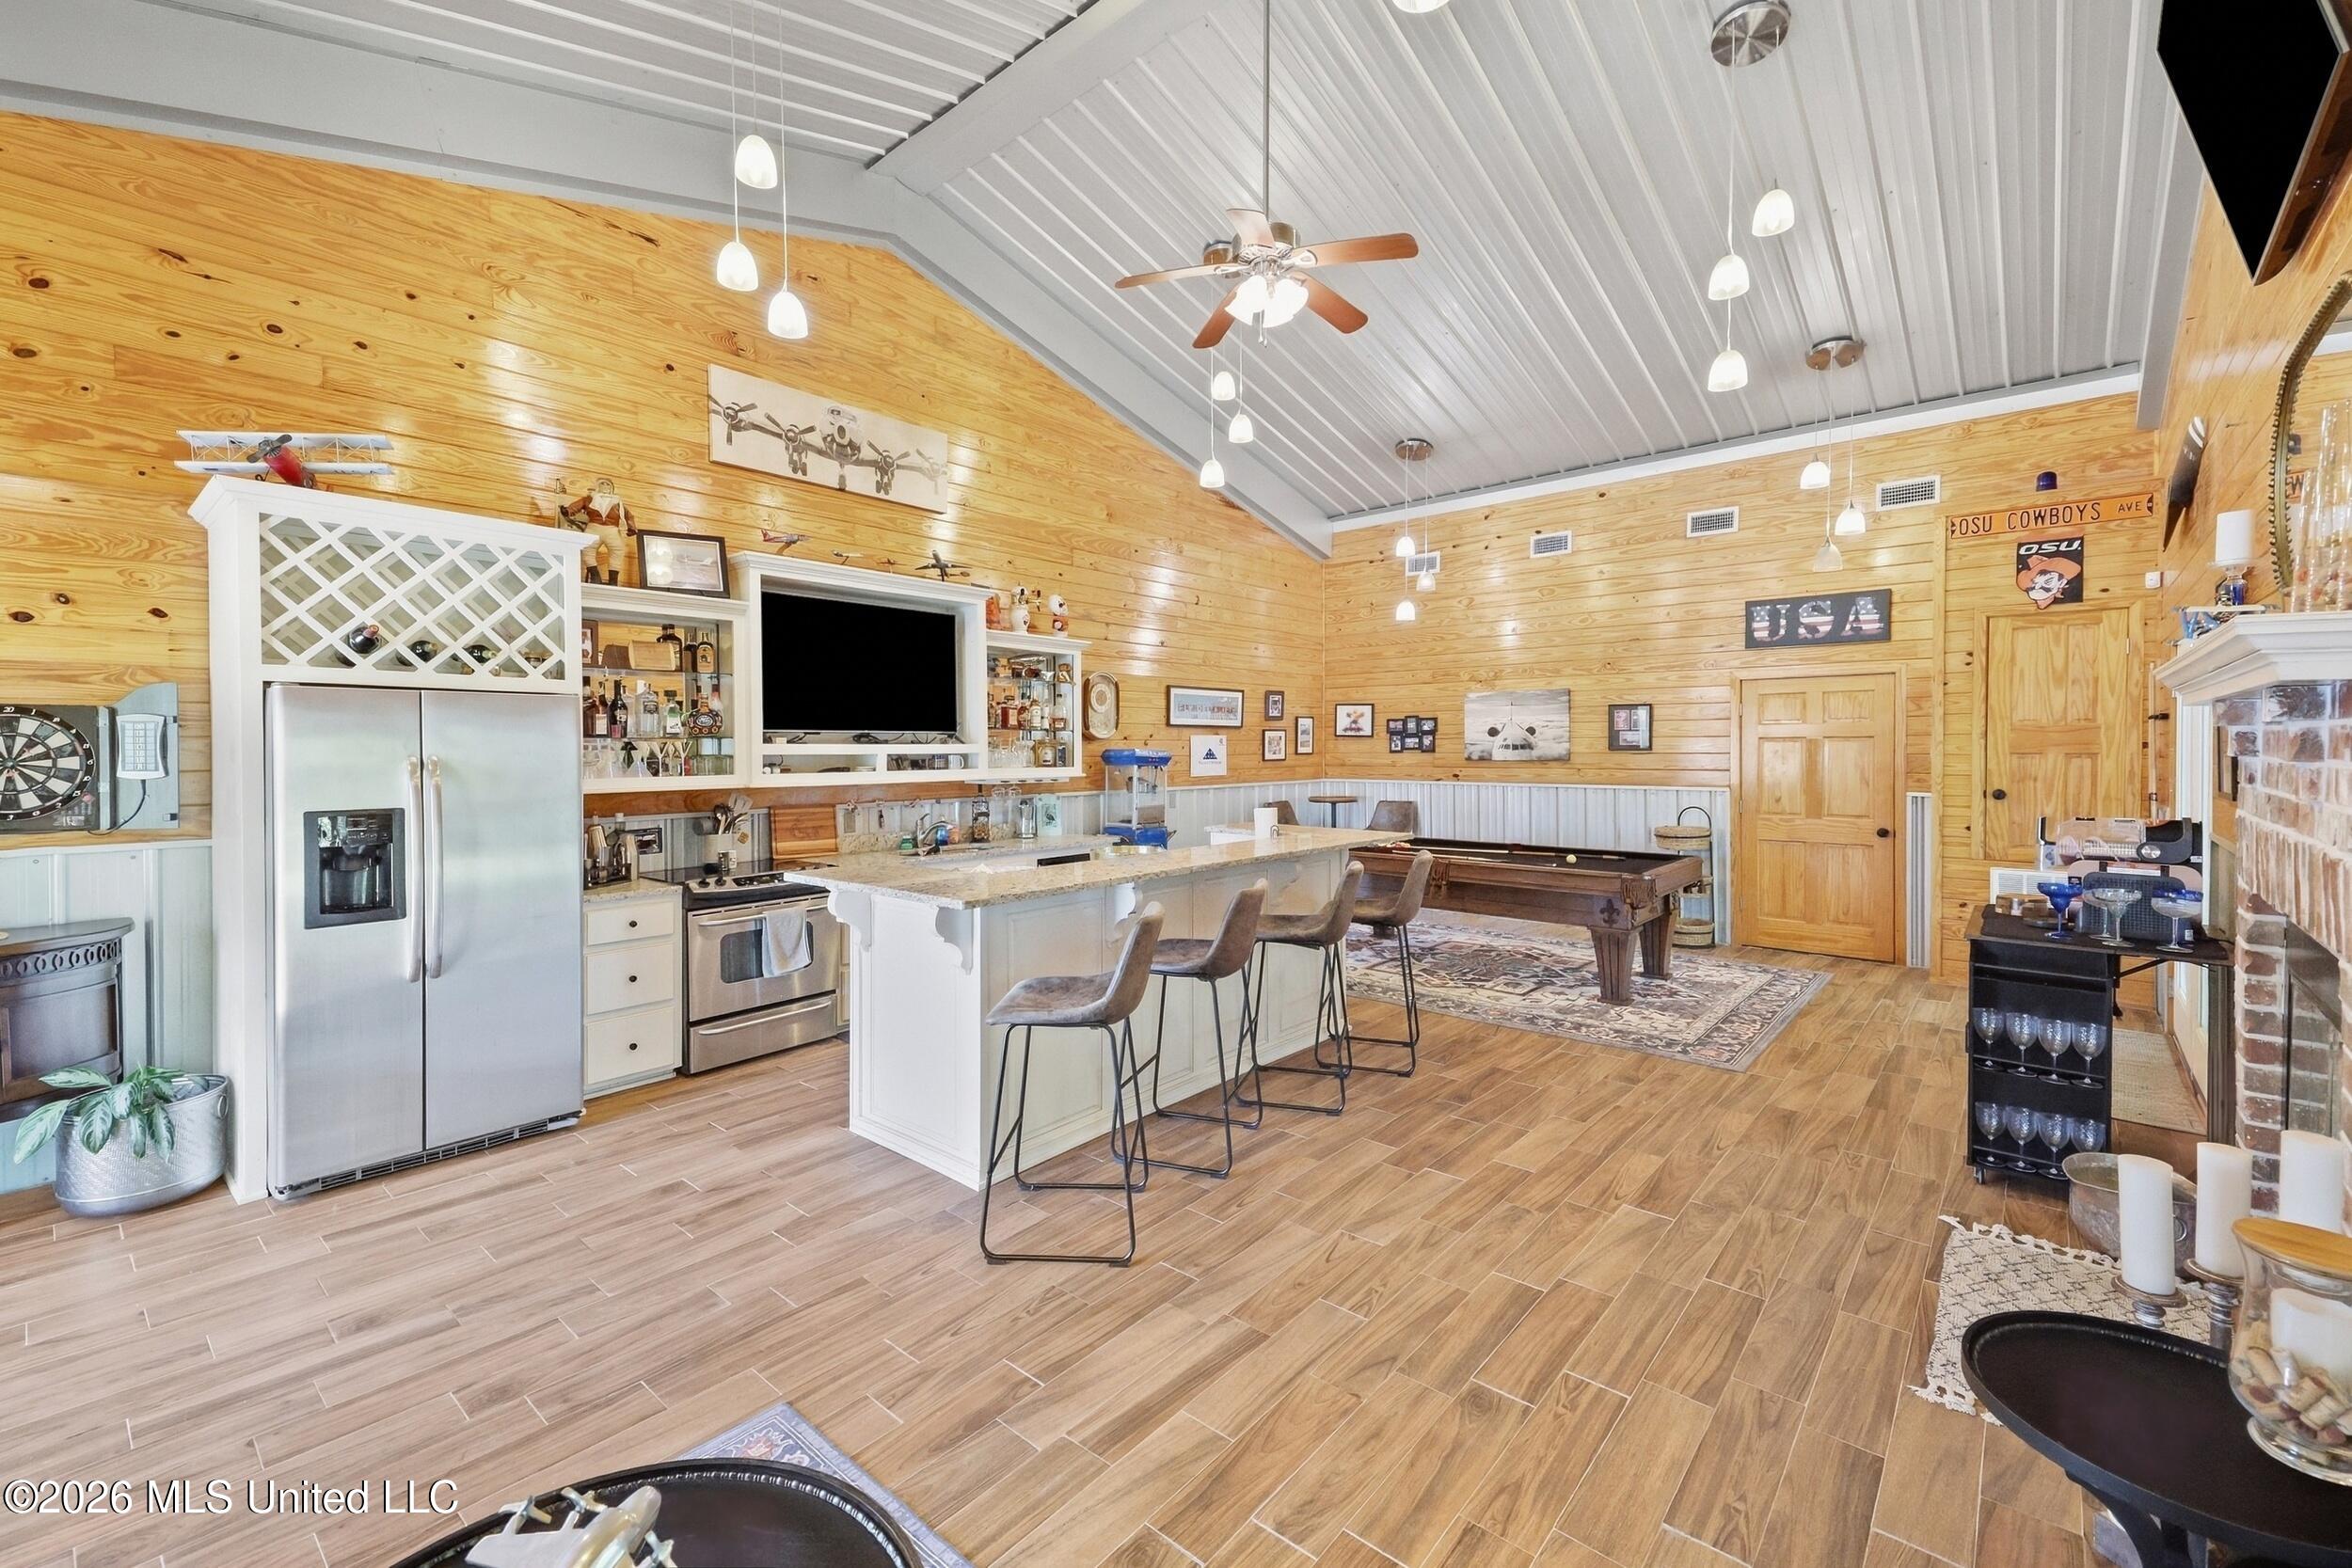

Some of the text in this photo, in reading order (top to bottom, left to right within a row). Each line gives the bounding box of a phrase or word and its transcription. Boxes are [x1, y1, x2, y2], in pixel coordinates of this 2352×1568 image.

[1959, 500, 2142, 536] OSU COWBOYS AVE
[2018, 539, 2080, 556] OSU
[1750, 596, 1884, 642] USA
